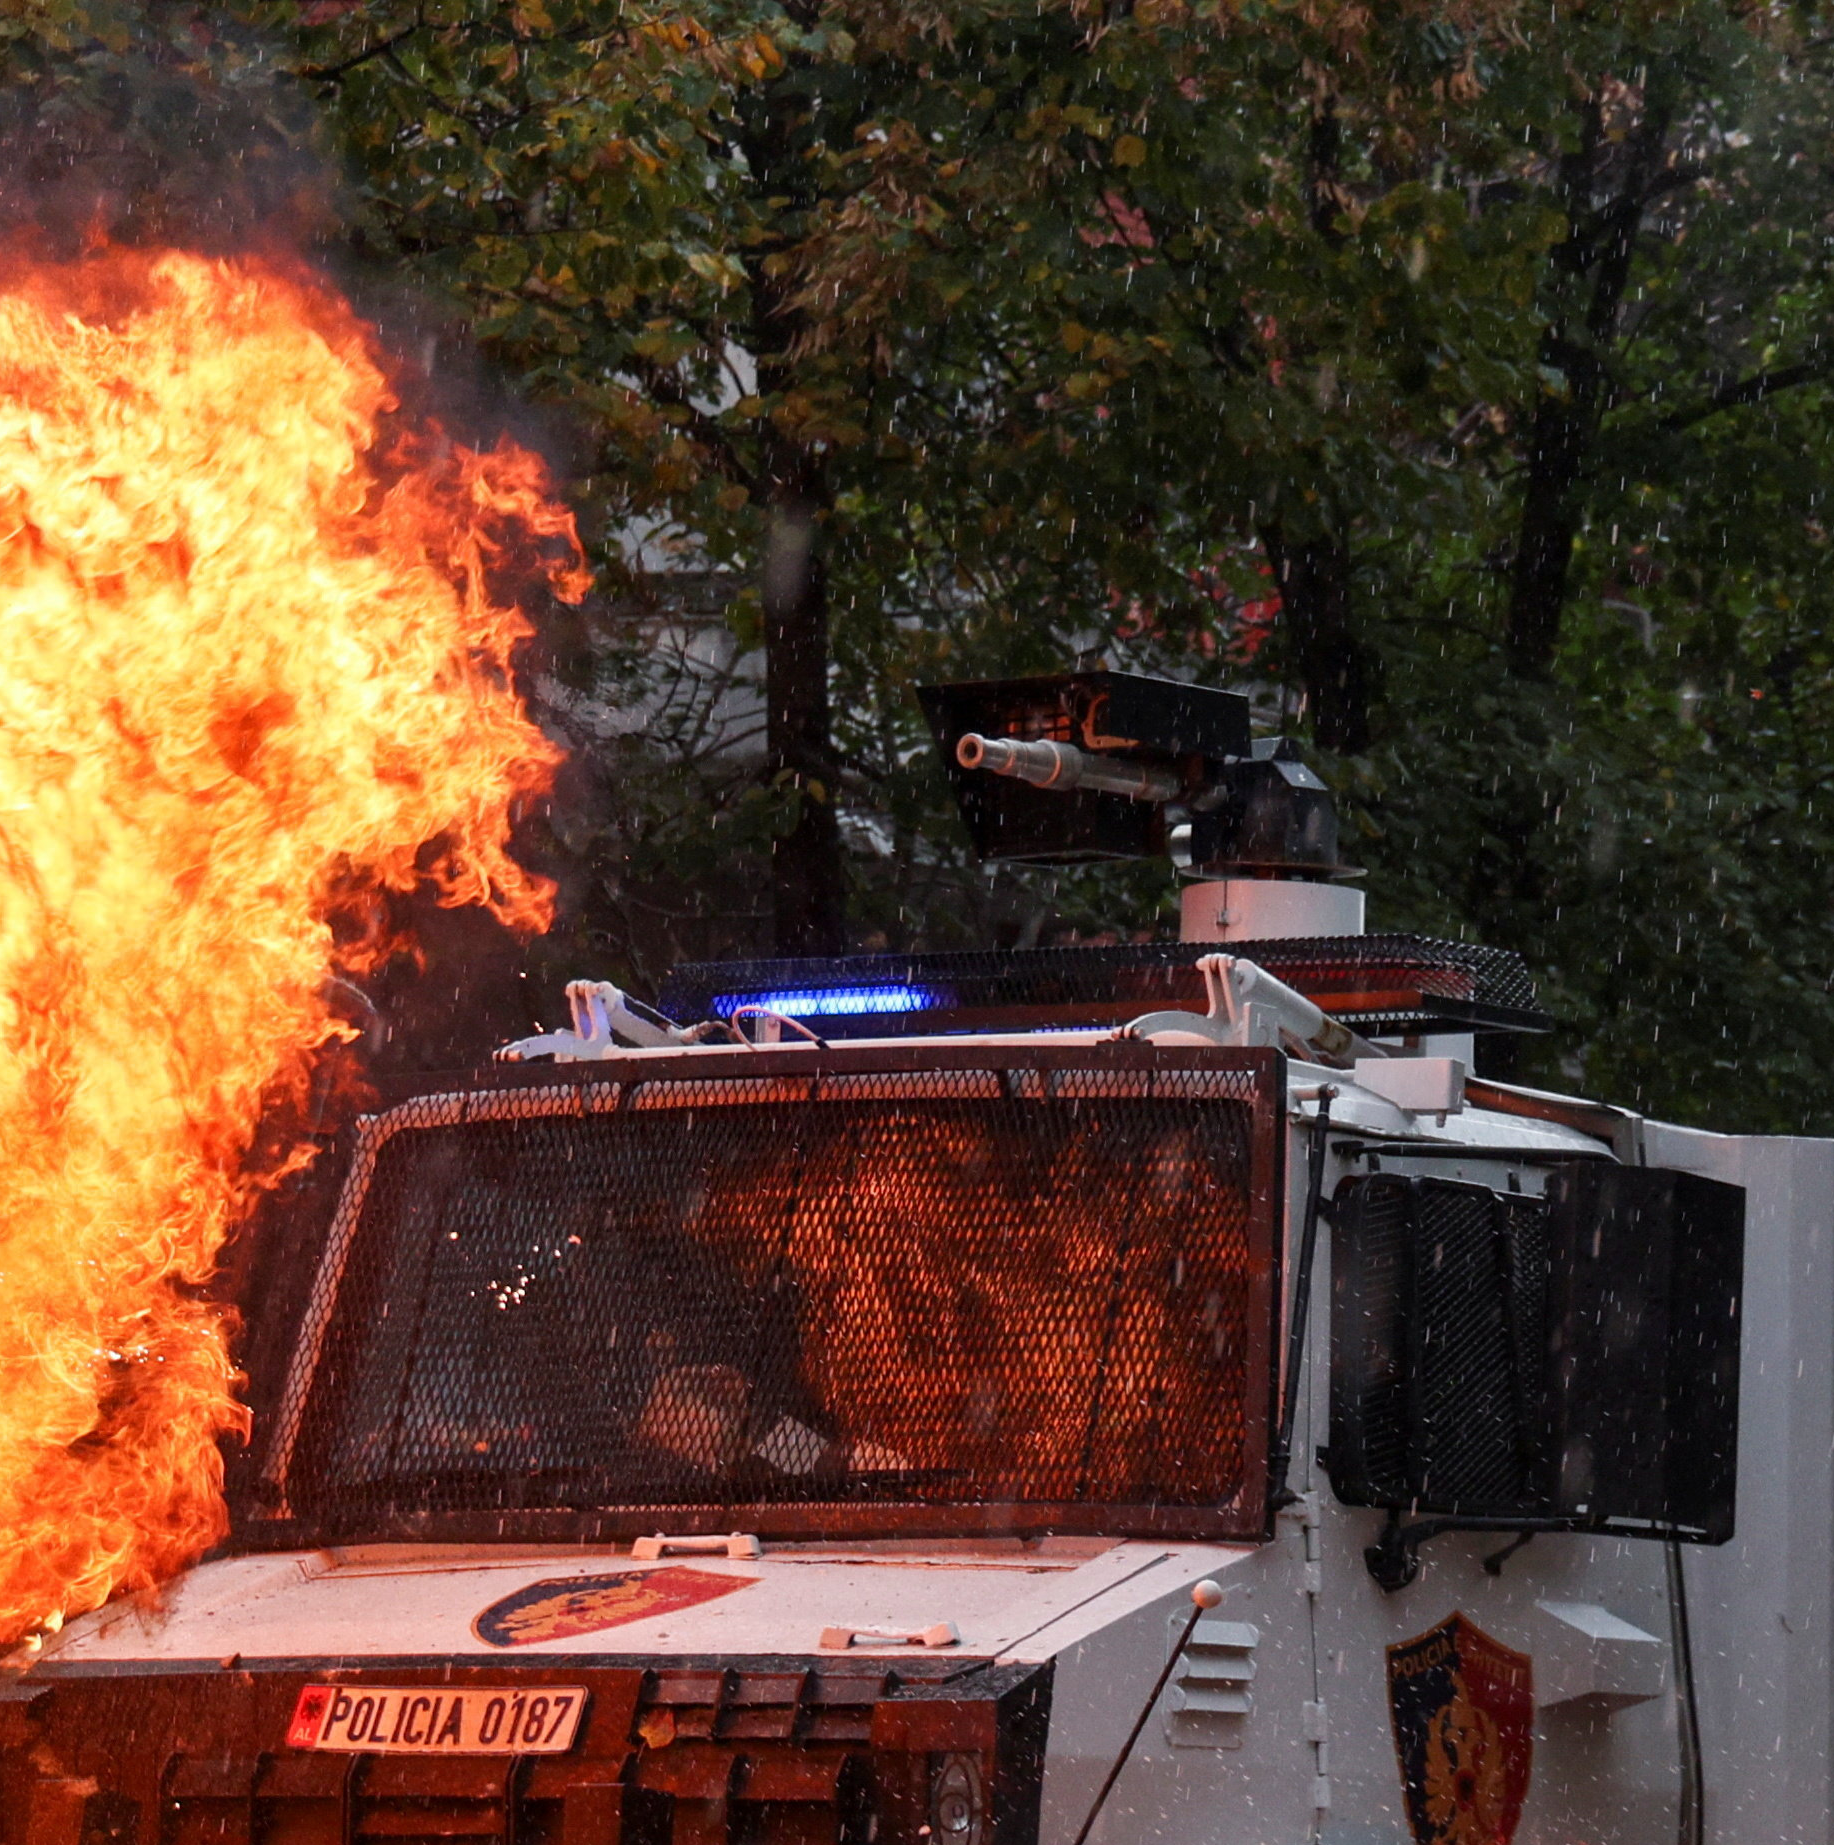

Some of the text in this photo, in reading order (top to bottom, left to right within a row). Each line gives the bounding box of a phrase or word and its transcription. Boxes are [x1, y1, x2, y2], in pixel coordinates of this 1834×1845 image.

[1392, 1637, 1453, 1679] POLICIA
[292, 1726, 314, 1742] AL
[322, 1691, 575, 1745] POLICIA 0187
